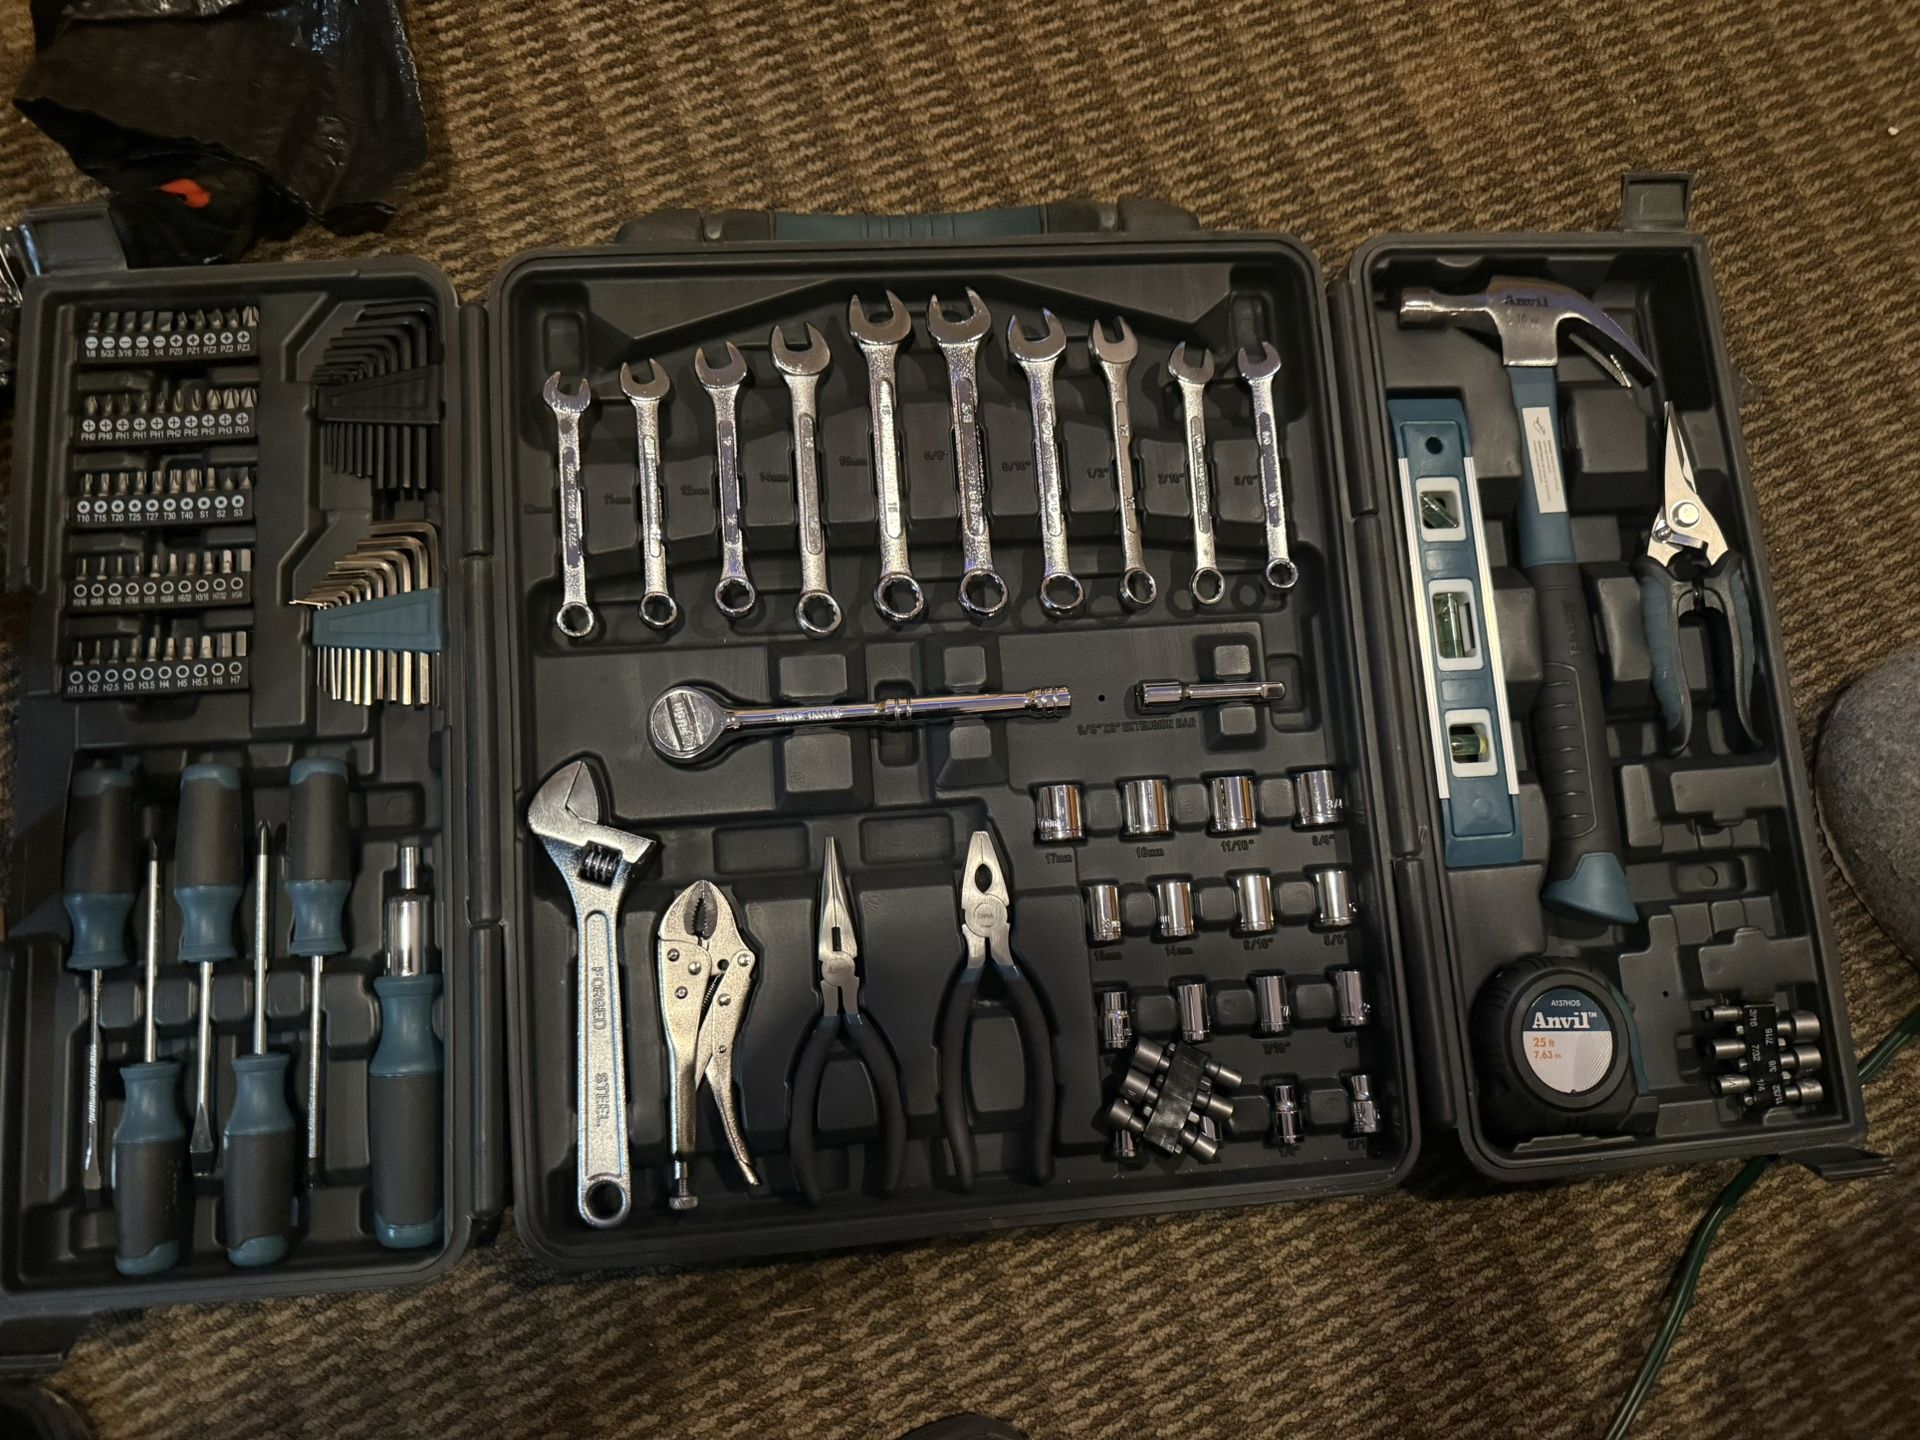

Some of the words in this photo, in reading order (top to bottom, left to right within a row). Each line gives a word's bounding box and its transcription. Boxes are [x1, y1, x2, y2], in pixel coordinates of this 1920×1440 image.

[77, 514, 90, 523] T10
[94, 514, 106, 522] T15
[111, 514, 124, 522] T20
[181, 511, 193, 519] T40
[68, 686, 84, 694] H1.5
[590, 966, 608, 1030] FORGED
[1749, 1008, 1758, 1027] 3/16
[1533, 1037, 1546, 1048] 25
[1549, 1038, 1555, 1048] ft
[1765, 1028, 1773, 1046] 7/16
[1534, 1051, 1553, 1059] 7.63
[1752, 1044, 1760, 1062] 7/32
[1768, 1060, 1777, 1073] 3/8
[1756, 1079, 1766, 1092] 1/4
[594, 1072, 610, 1127] STEEL
[1772, 1084, 1783, 1105] 11/32
